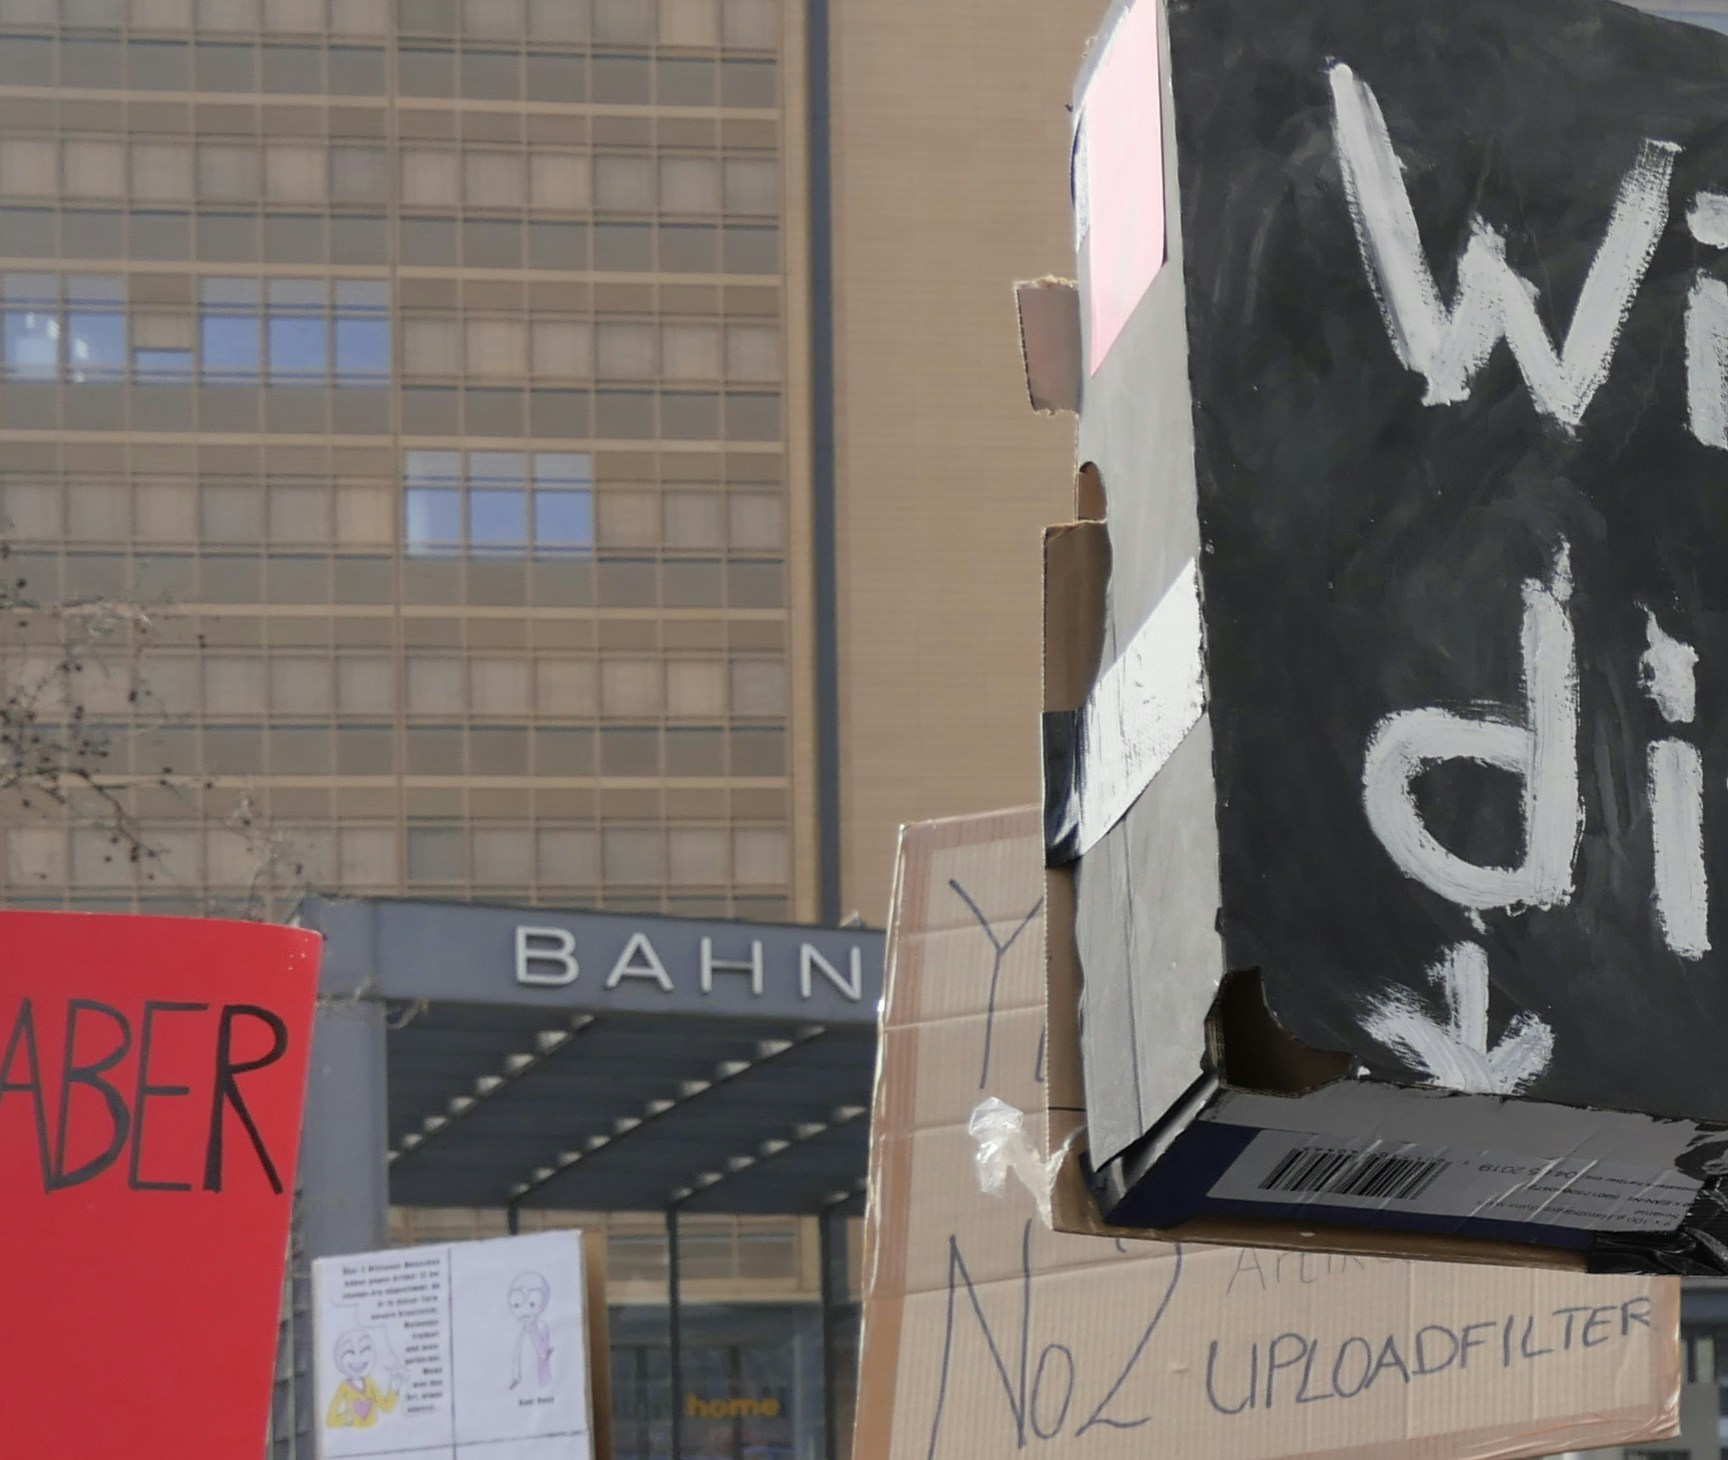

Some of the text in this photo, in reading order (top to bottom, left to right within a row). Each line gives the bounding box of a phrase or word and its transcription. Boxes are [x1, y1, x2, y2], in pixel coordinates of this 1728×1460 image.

[514, 924, 862, 1002] BAHN
[0, 996, 288, 1195] ABER
[686, 1391, 781, 1418] home
[1206, 1295, 1653, 1415] UPLOADFILTER
